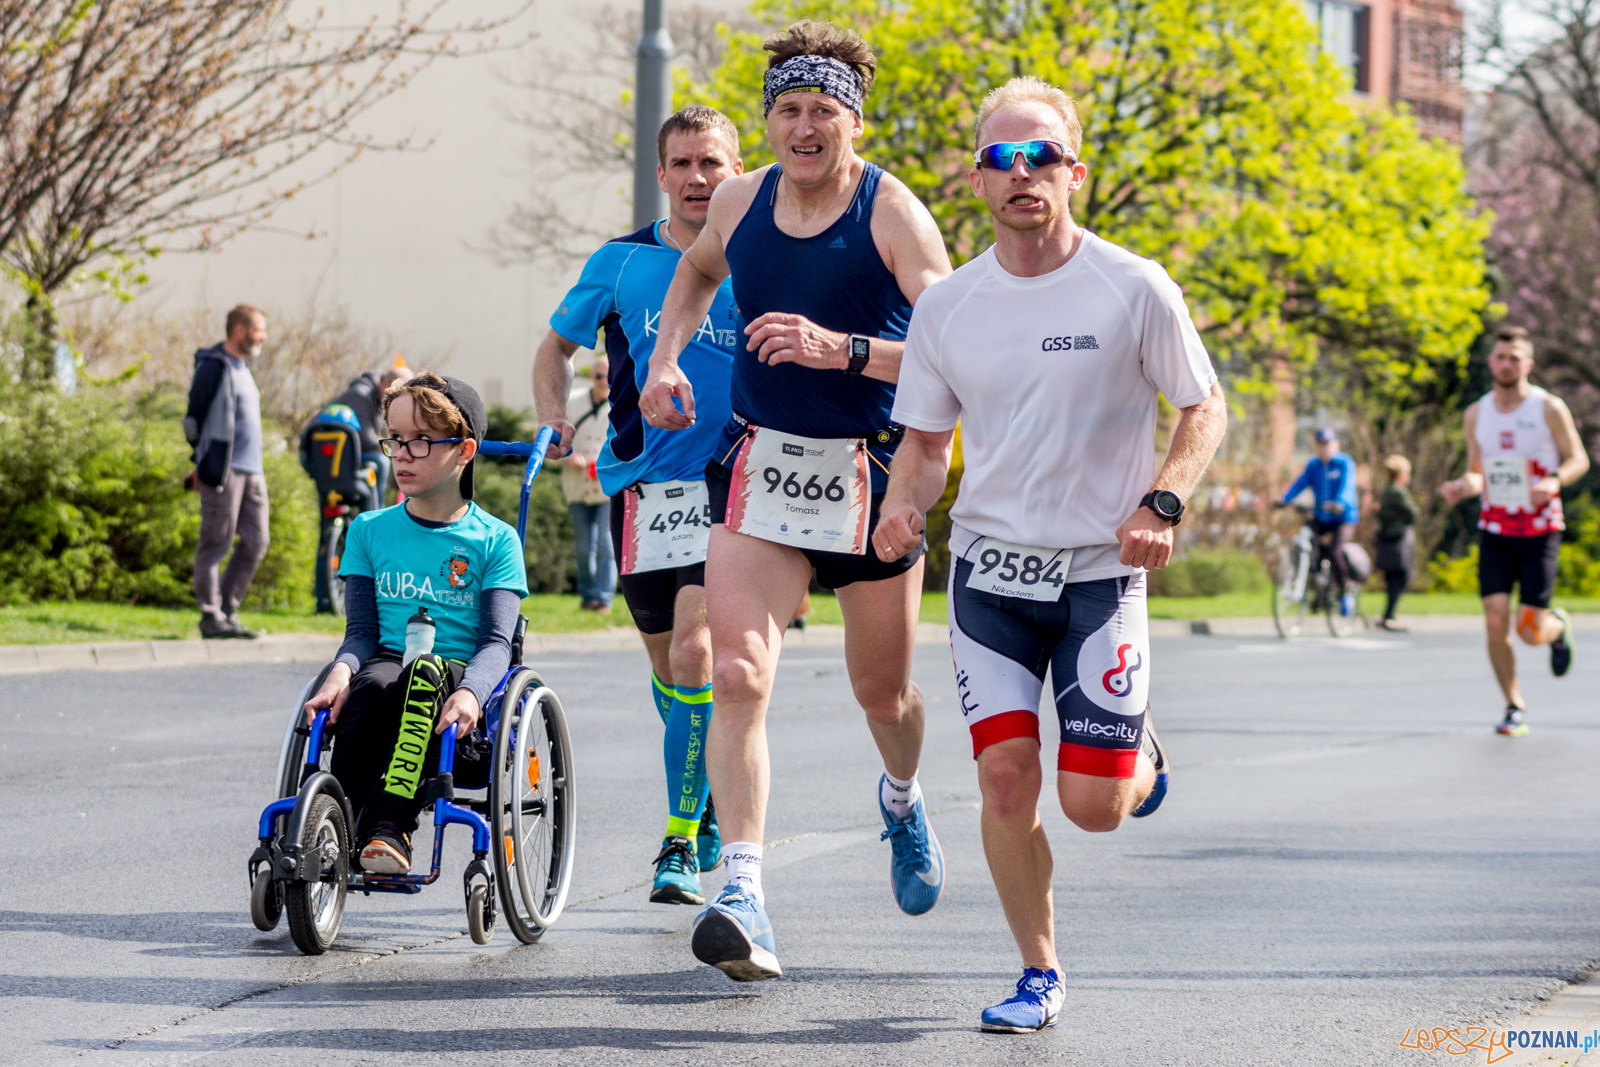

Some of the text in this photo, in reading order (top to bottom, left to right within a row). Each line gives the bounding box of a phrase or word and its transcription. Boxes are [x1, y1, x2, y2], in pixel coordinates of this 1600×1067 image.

[644, 308, 716, 344] KA
[1042, 336, 1072, 352] GSS
[312, 431, 347, 479] 7
[763, 466, 845, 502] 9666
[649, 503, 711, 534] 4945
[785, 503, 820, 516] Tomasz
[672, 533, 694, 541] Adam
[978, 548, 1064, 588] 9584
[991, 584, 1034, 599] Nikodem
[1065, 717, 1138, 743] velocity
